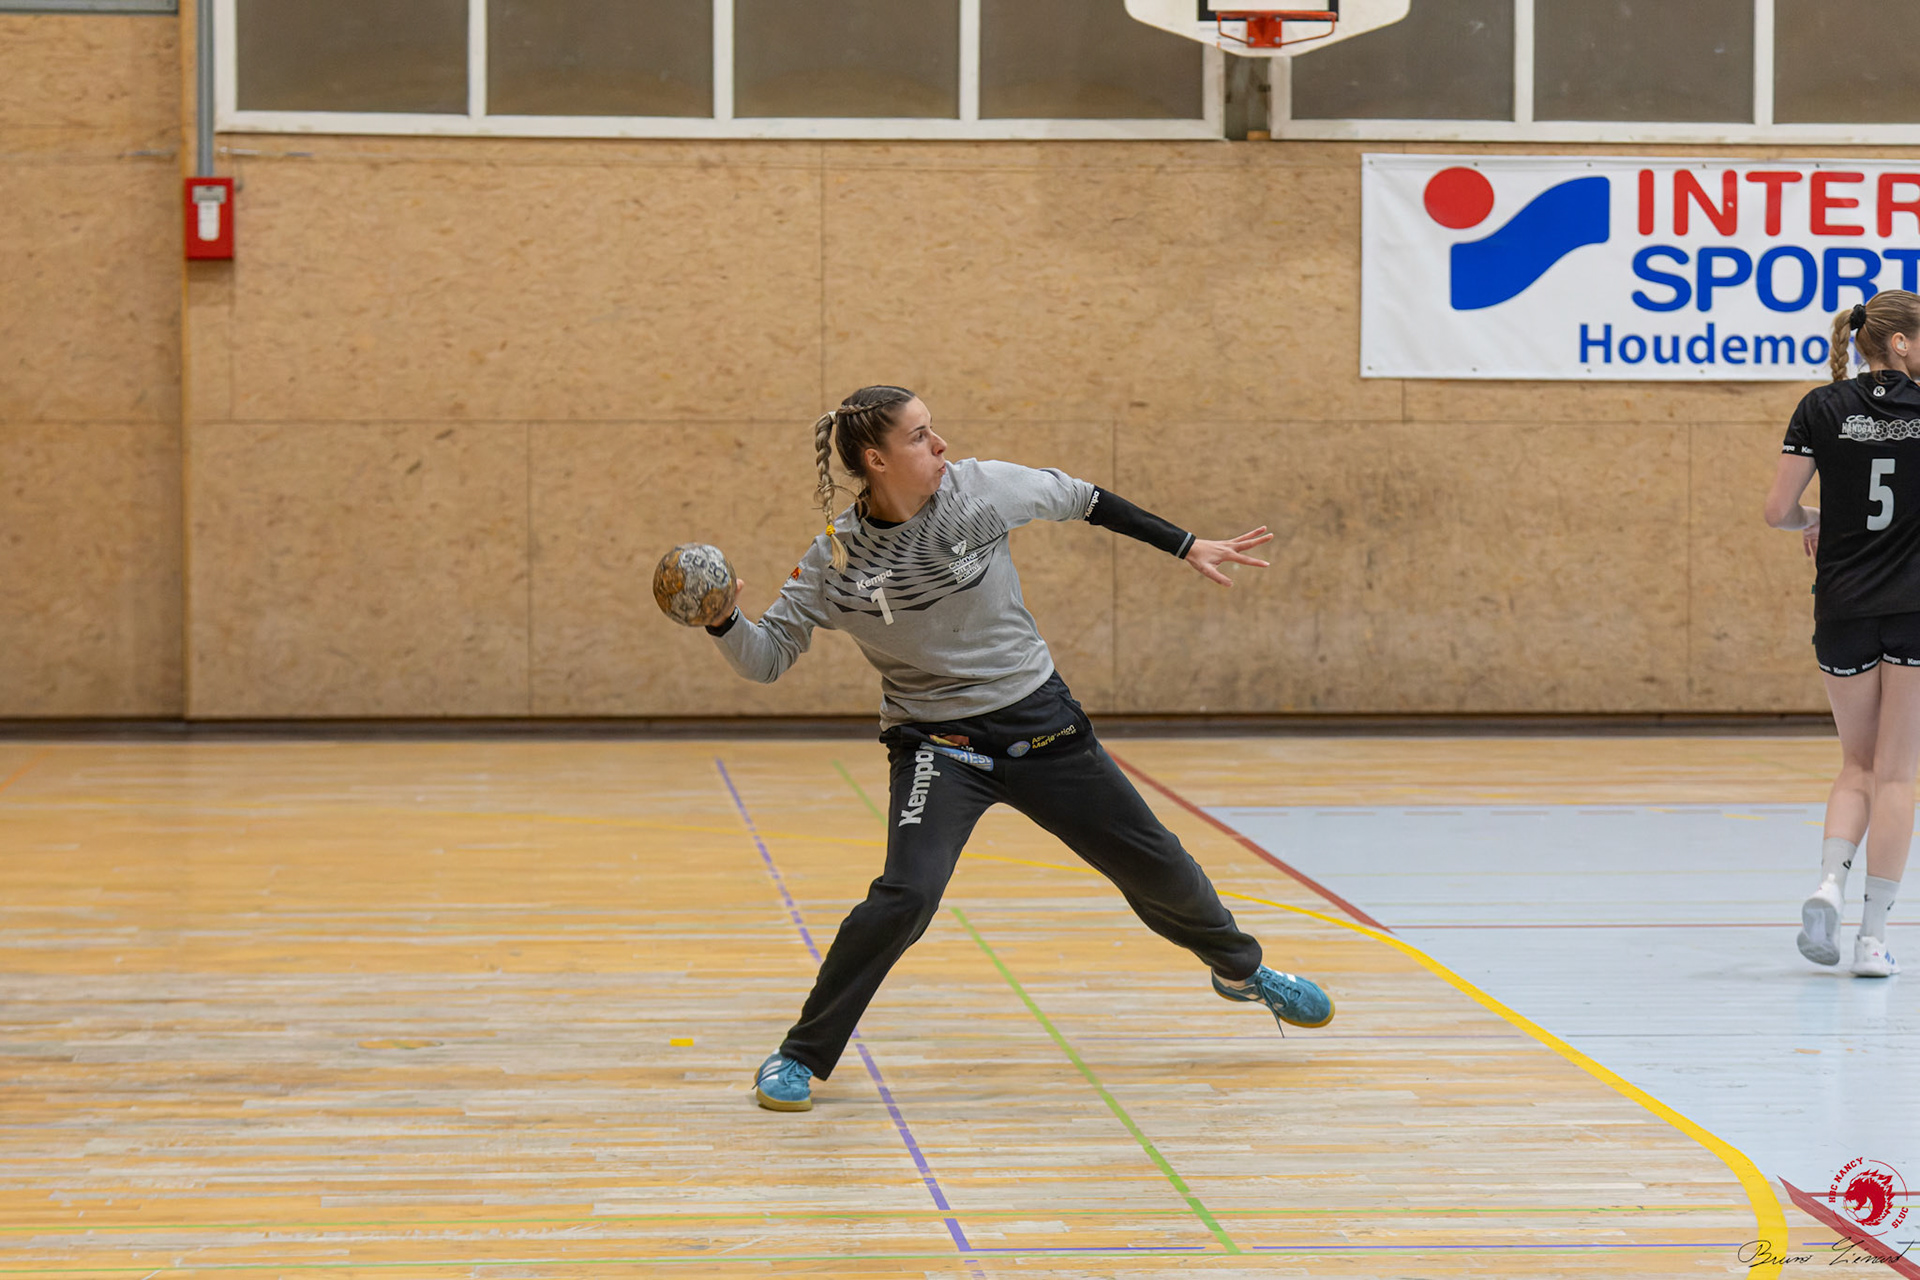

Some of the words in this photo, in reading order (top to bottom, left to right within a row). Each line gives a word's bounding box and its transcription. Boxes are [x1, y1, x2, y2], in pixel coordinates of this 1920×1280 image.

[1638, 169, 1920, 238] INTER
[1631, 244, 1920, 313] SPORT
[1579, 322, 1862, 366] Houdemo
[1866, 458, 1896, 532] 5
[856, 569, 893, 591] Kempa
[870, 587, 894, 626] 1
[898, 750, 940, 827] Kempa
